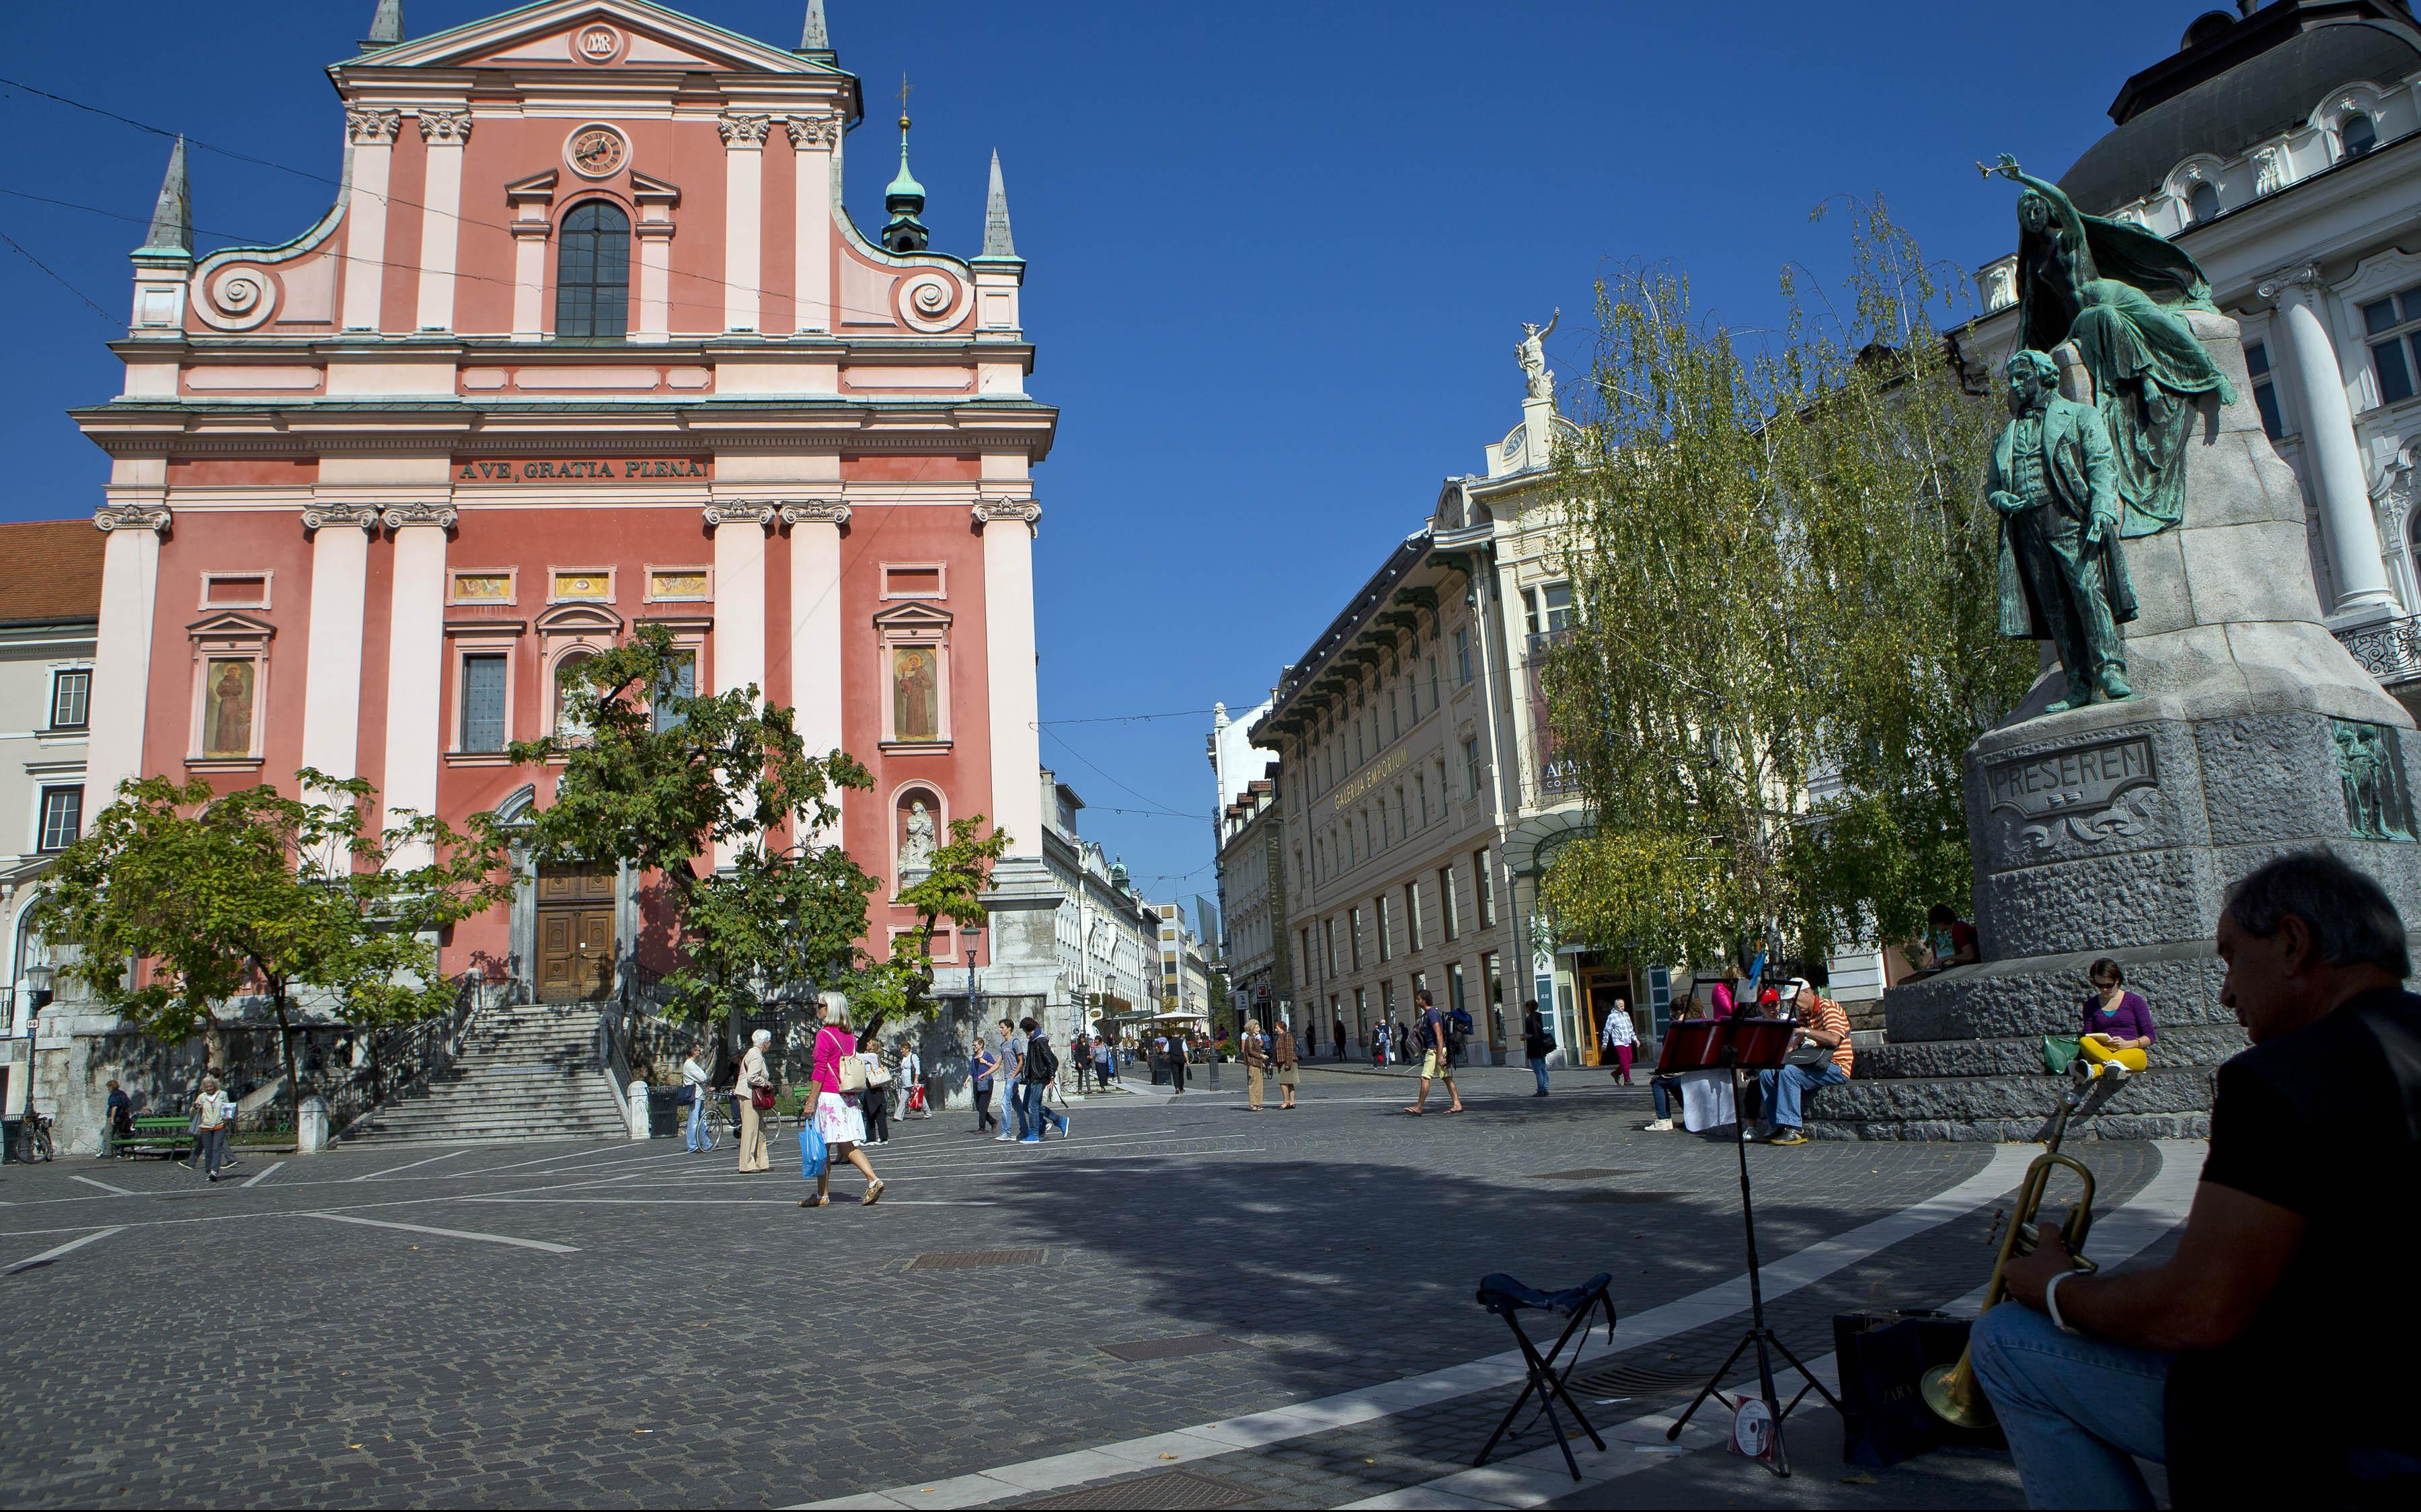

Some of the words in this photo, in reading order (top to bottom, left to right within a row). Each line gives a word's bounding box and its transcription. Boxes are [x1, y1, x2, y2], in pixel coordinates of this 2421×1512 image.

[459, 462, 520, 483] AVE,
[523, 461, 615, 479] GRATIA
[625, 460, 709, 478] PLENA!
[1335, 777, 1365, 810] GALERIJA
[1367, 746, 1408, 788] EMPORIUM
